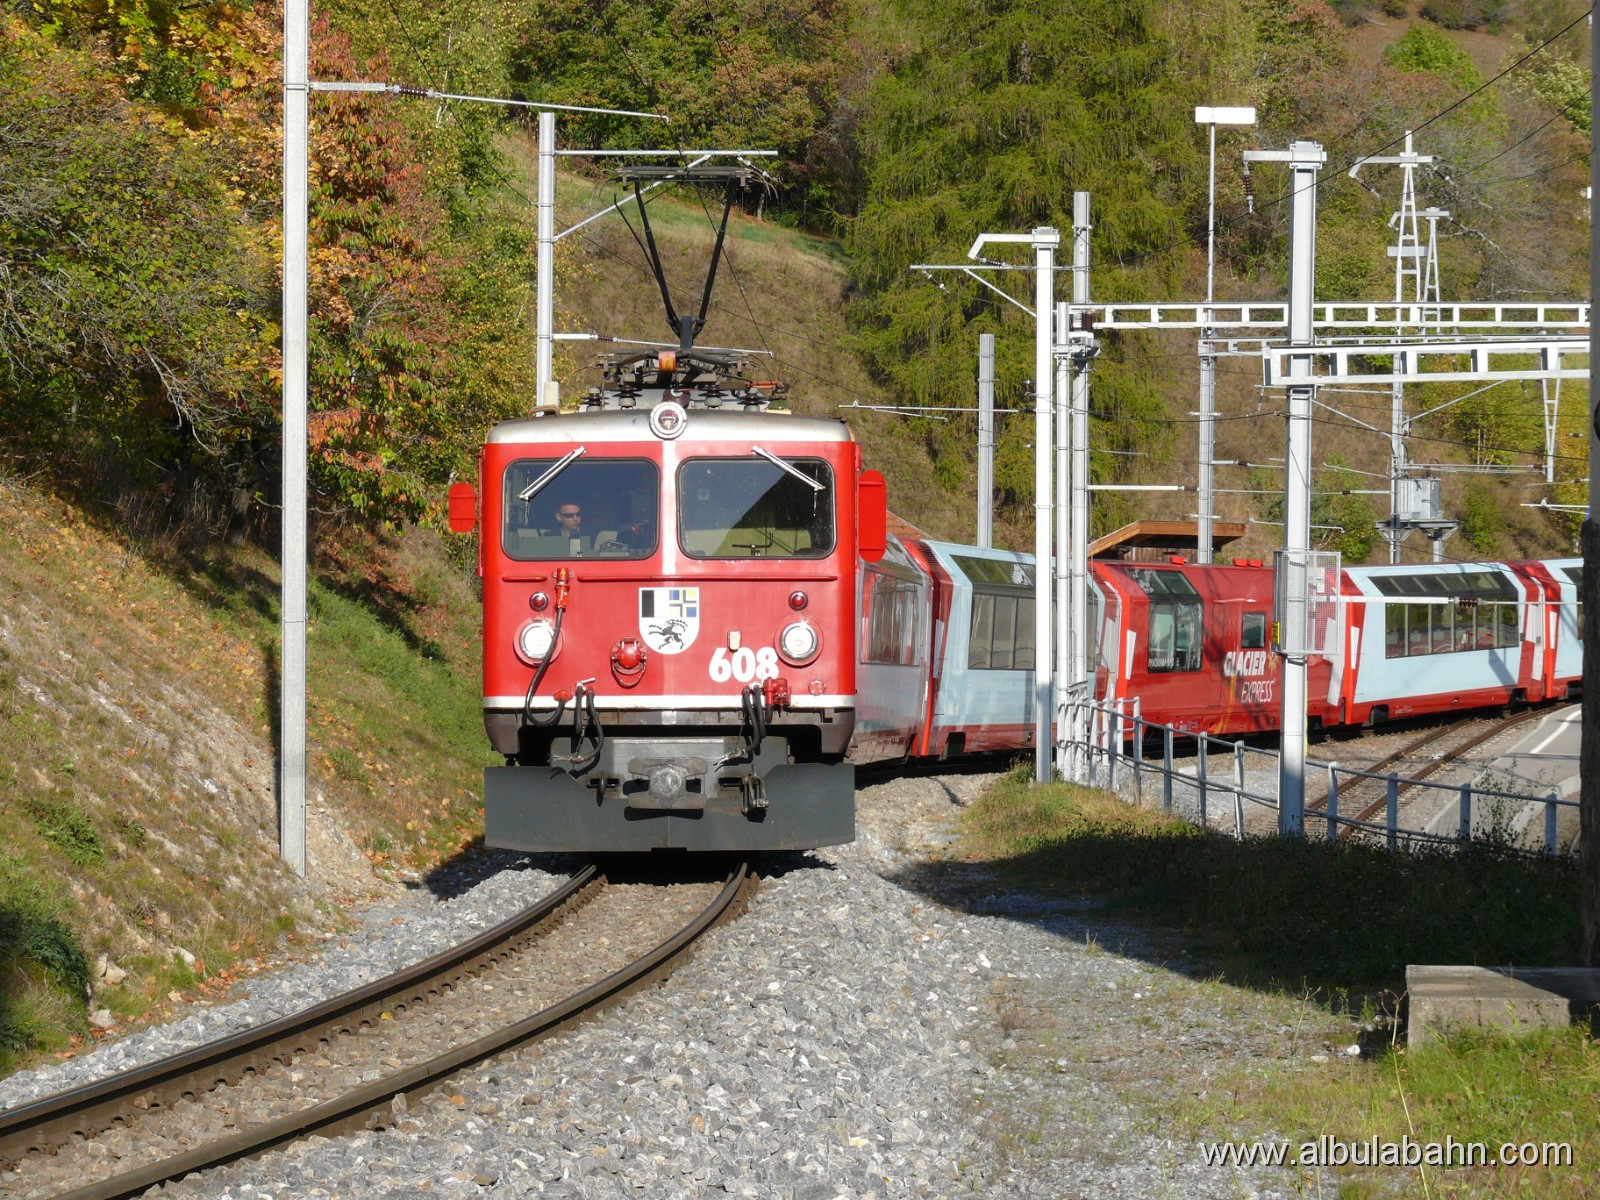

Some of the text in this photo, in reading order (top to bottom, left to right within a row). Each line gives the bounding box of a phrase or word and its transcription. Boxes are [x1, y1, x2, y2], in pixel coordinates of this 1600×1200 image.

[709, 647, 779, 683] 608
[1223, 651, 1267, 677] GLACIER
[1241, 680, 1275, 703] EXPRESS
